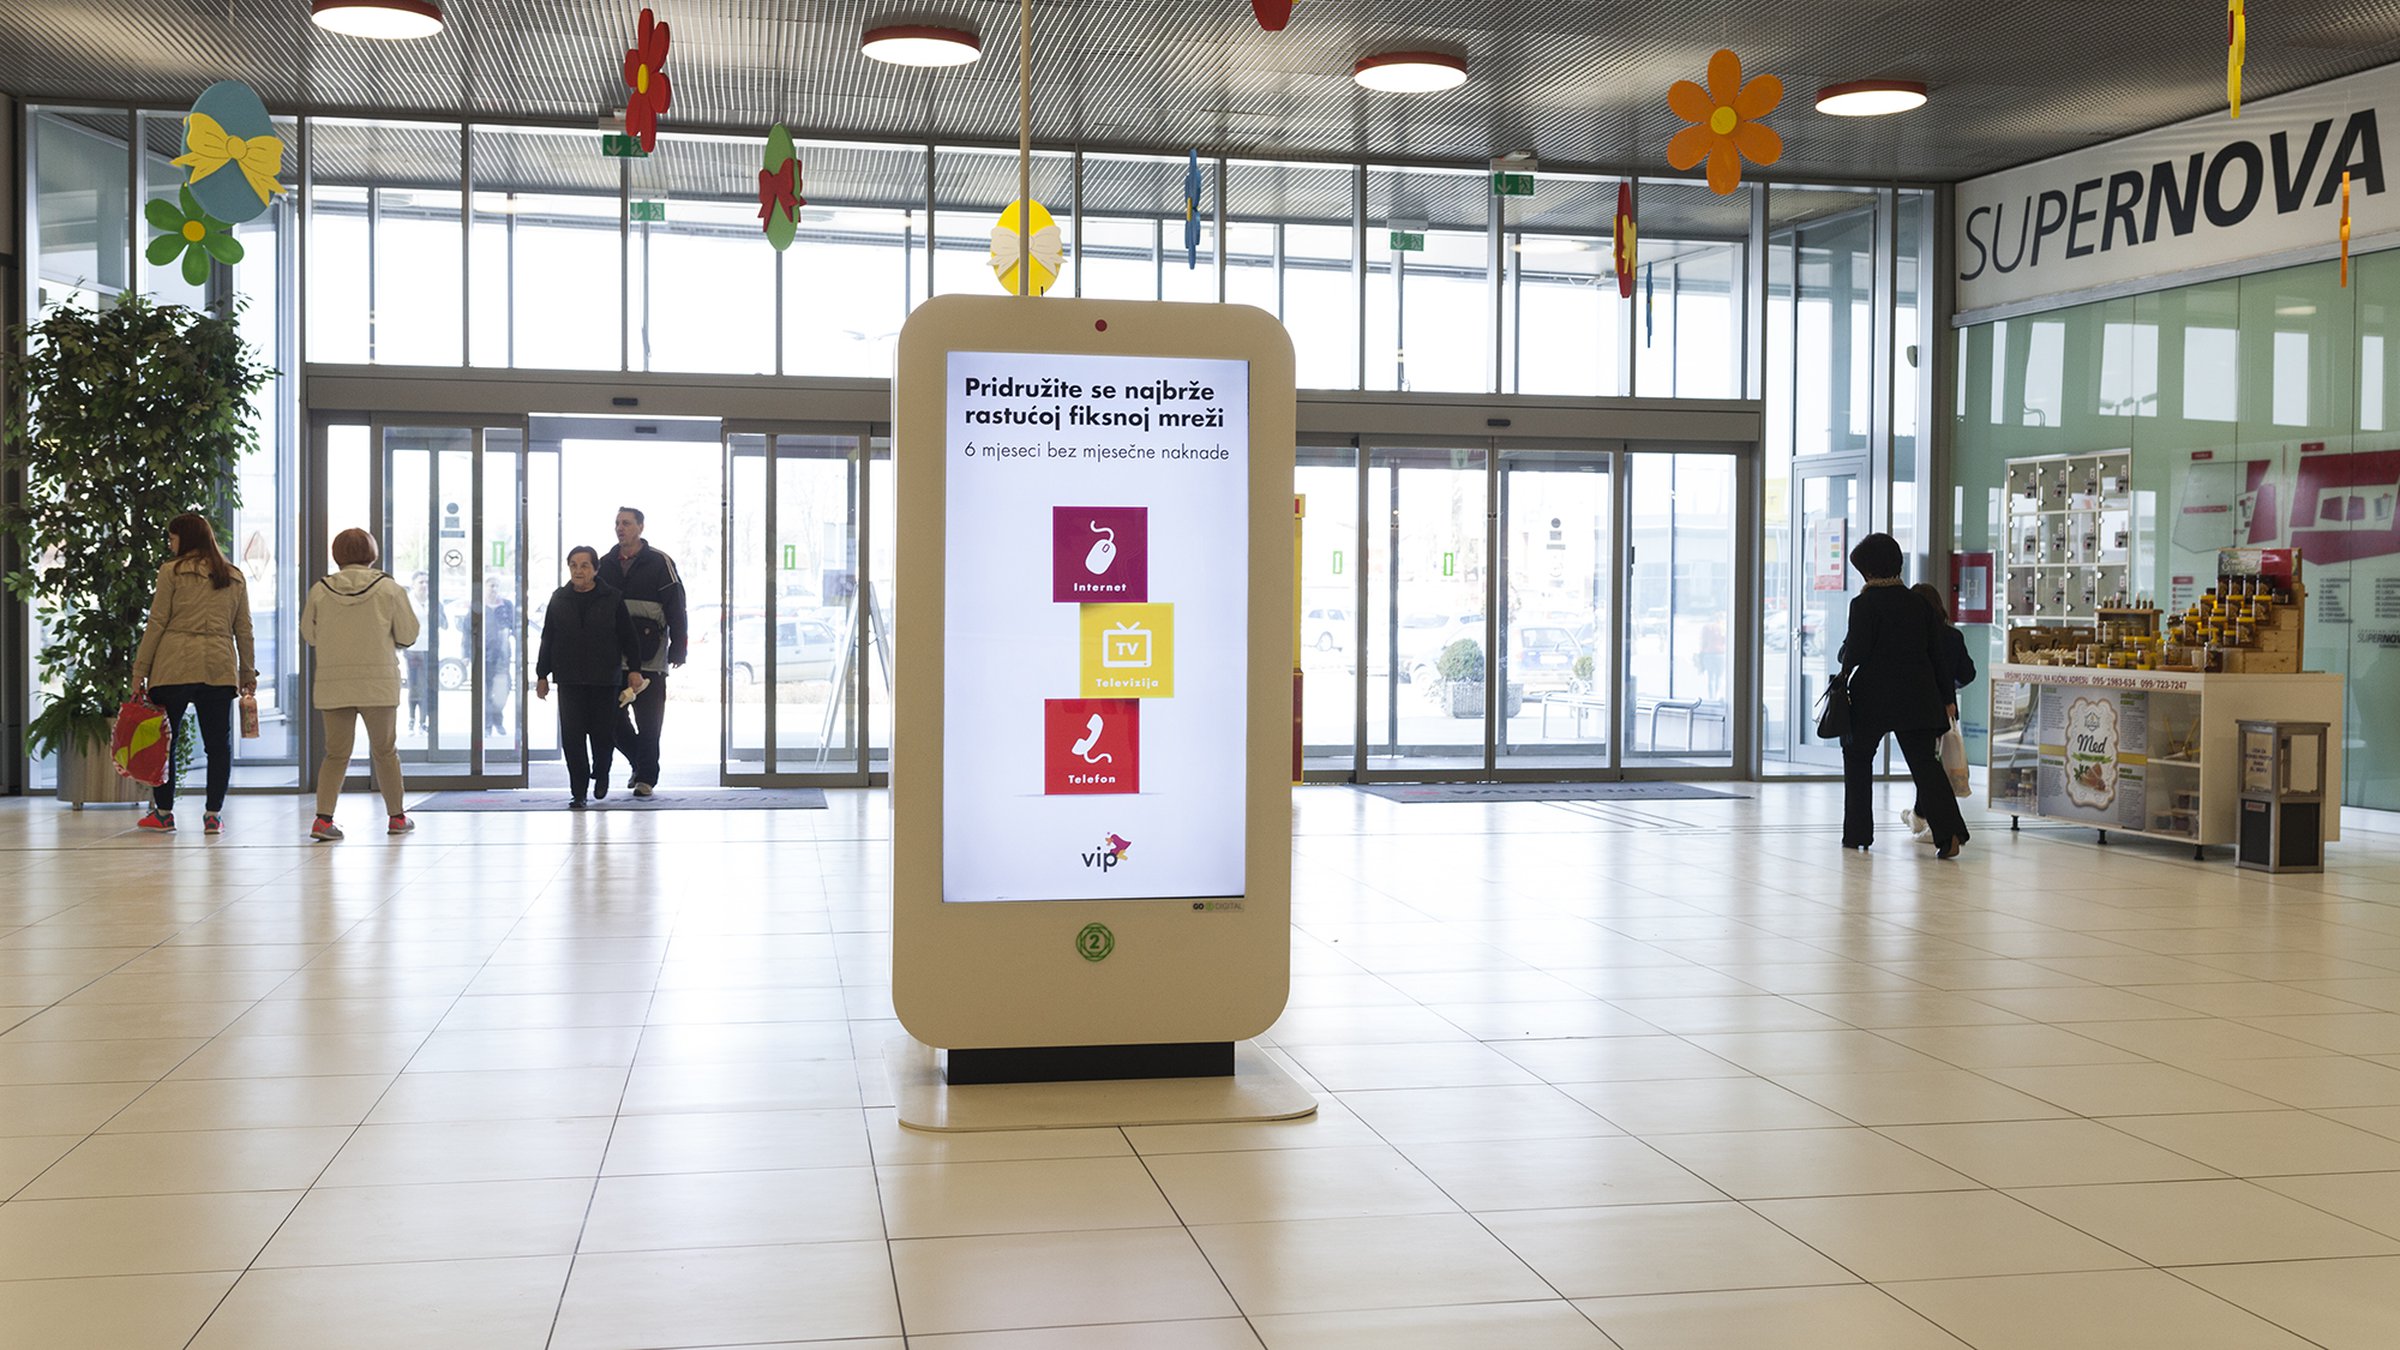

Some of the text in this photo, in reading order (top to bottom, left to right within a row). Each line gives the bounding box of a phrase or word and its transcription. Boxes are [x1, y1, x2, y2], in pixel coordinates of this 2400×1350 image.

[1960, 108, 2386, 282] SUPERNOVA
[965, 377, 1215, 405] Pridružite se najbrže
[965, 405, 1224, 432] rastućoj fiksnoj mreži
[964, 441, 1229, 462] 6 mjeseci bez mjesečne naknade
[1073, 582, 1127, 592] Internet
[1116, 642, 1139, 656] TV
[1096, 678, 1159, 689] Televizija
[2077, 734, 2108, 754] Med
[1068, 774, 1116, 784] Telefon
[1081, 846, 1118, 872] vip
[1089, 934, 1100, 949] 2
